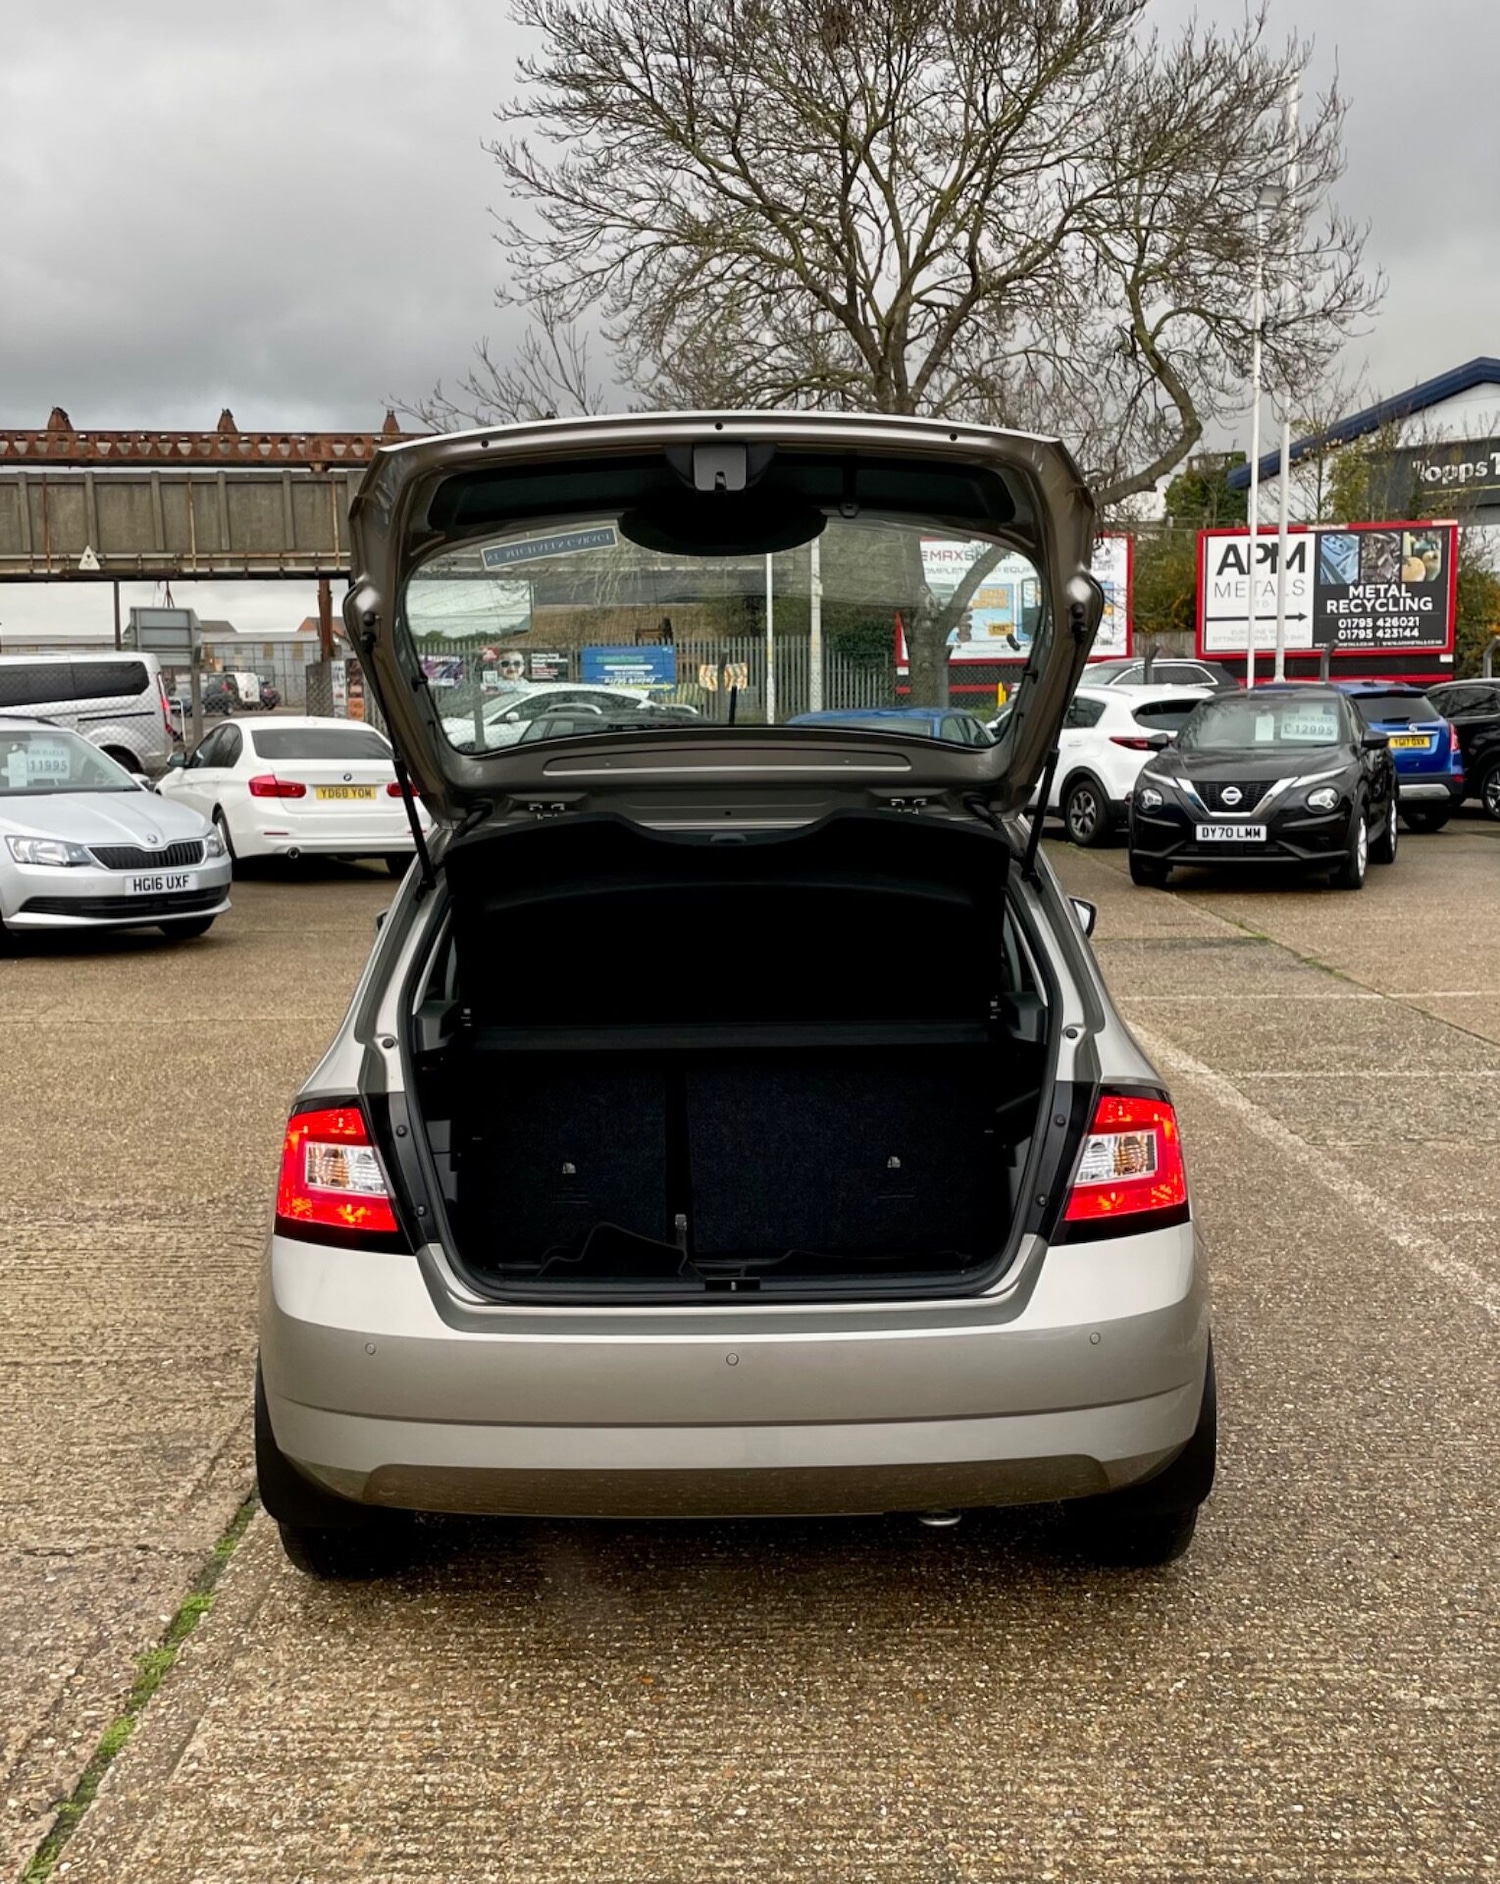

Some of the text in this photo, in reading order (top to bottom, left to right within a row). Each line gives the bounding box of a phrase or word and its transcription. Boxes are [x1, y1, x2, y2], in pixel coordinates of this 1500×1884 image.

[1216, 541, 1306, 576] APM
[1349, 583, 1412, 599] METAL
[1326, 597, 1433, 614] RECYCLING
[1338, 616, 1420, 629] 01795 426021
[1338, 627, 1420, 640] 01795 423144
[1201, 826, 1234, 839] DY70
[133, 874, 190, 893] HG16 UXF
